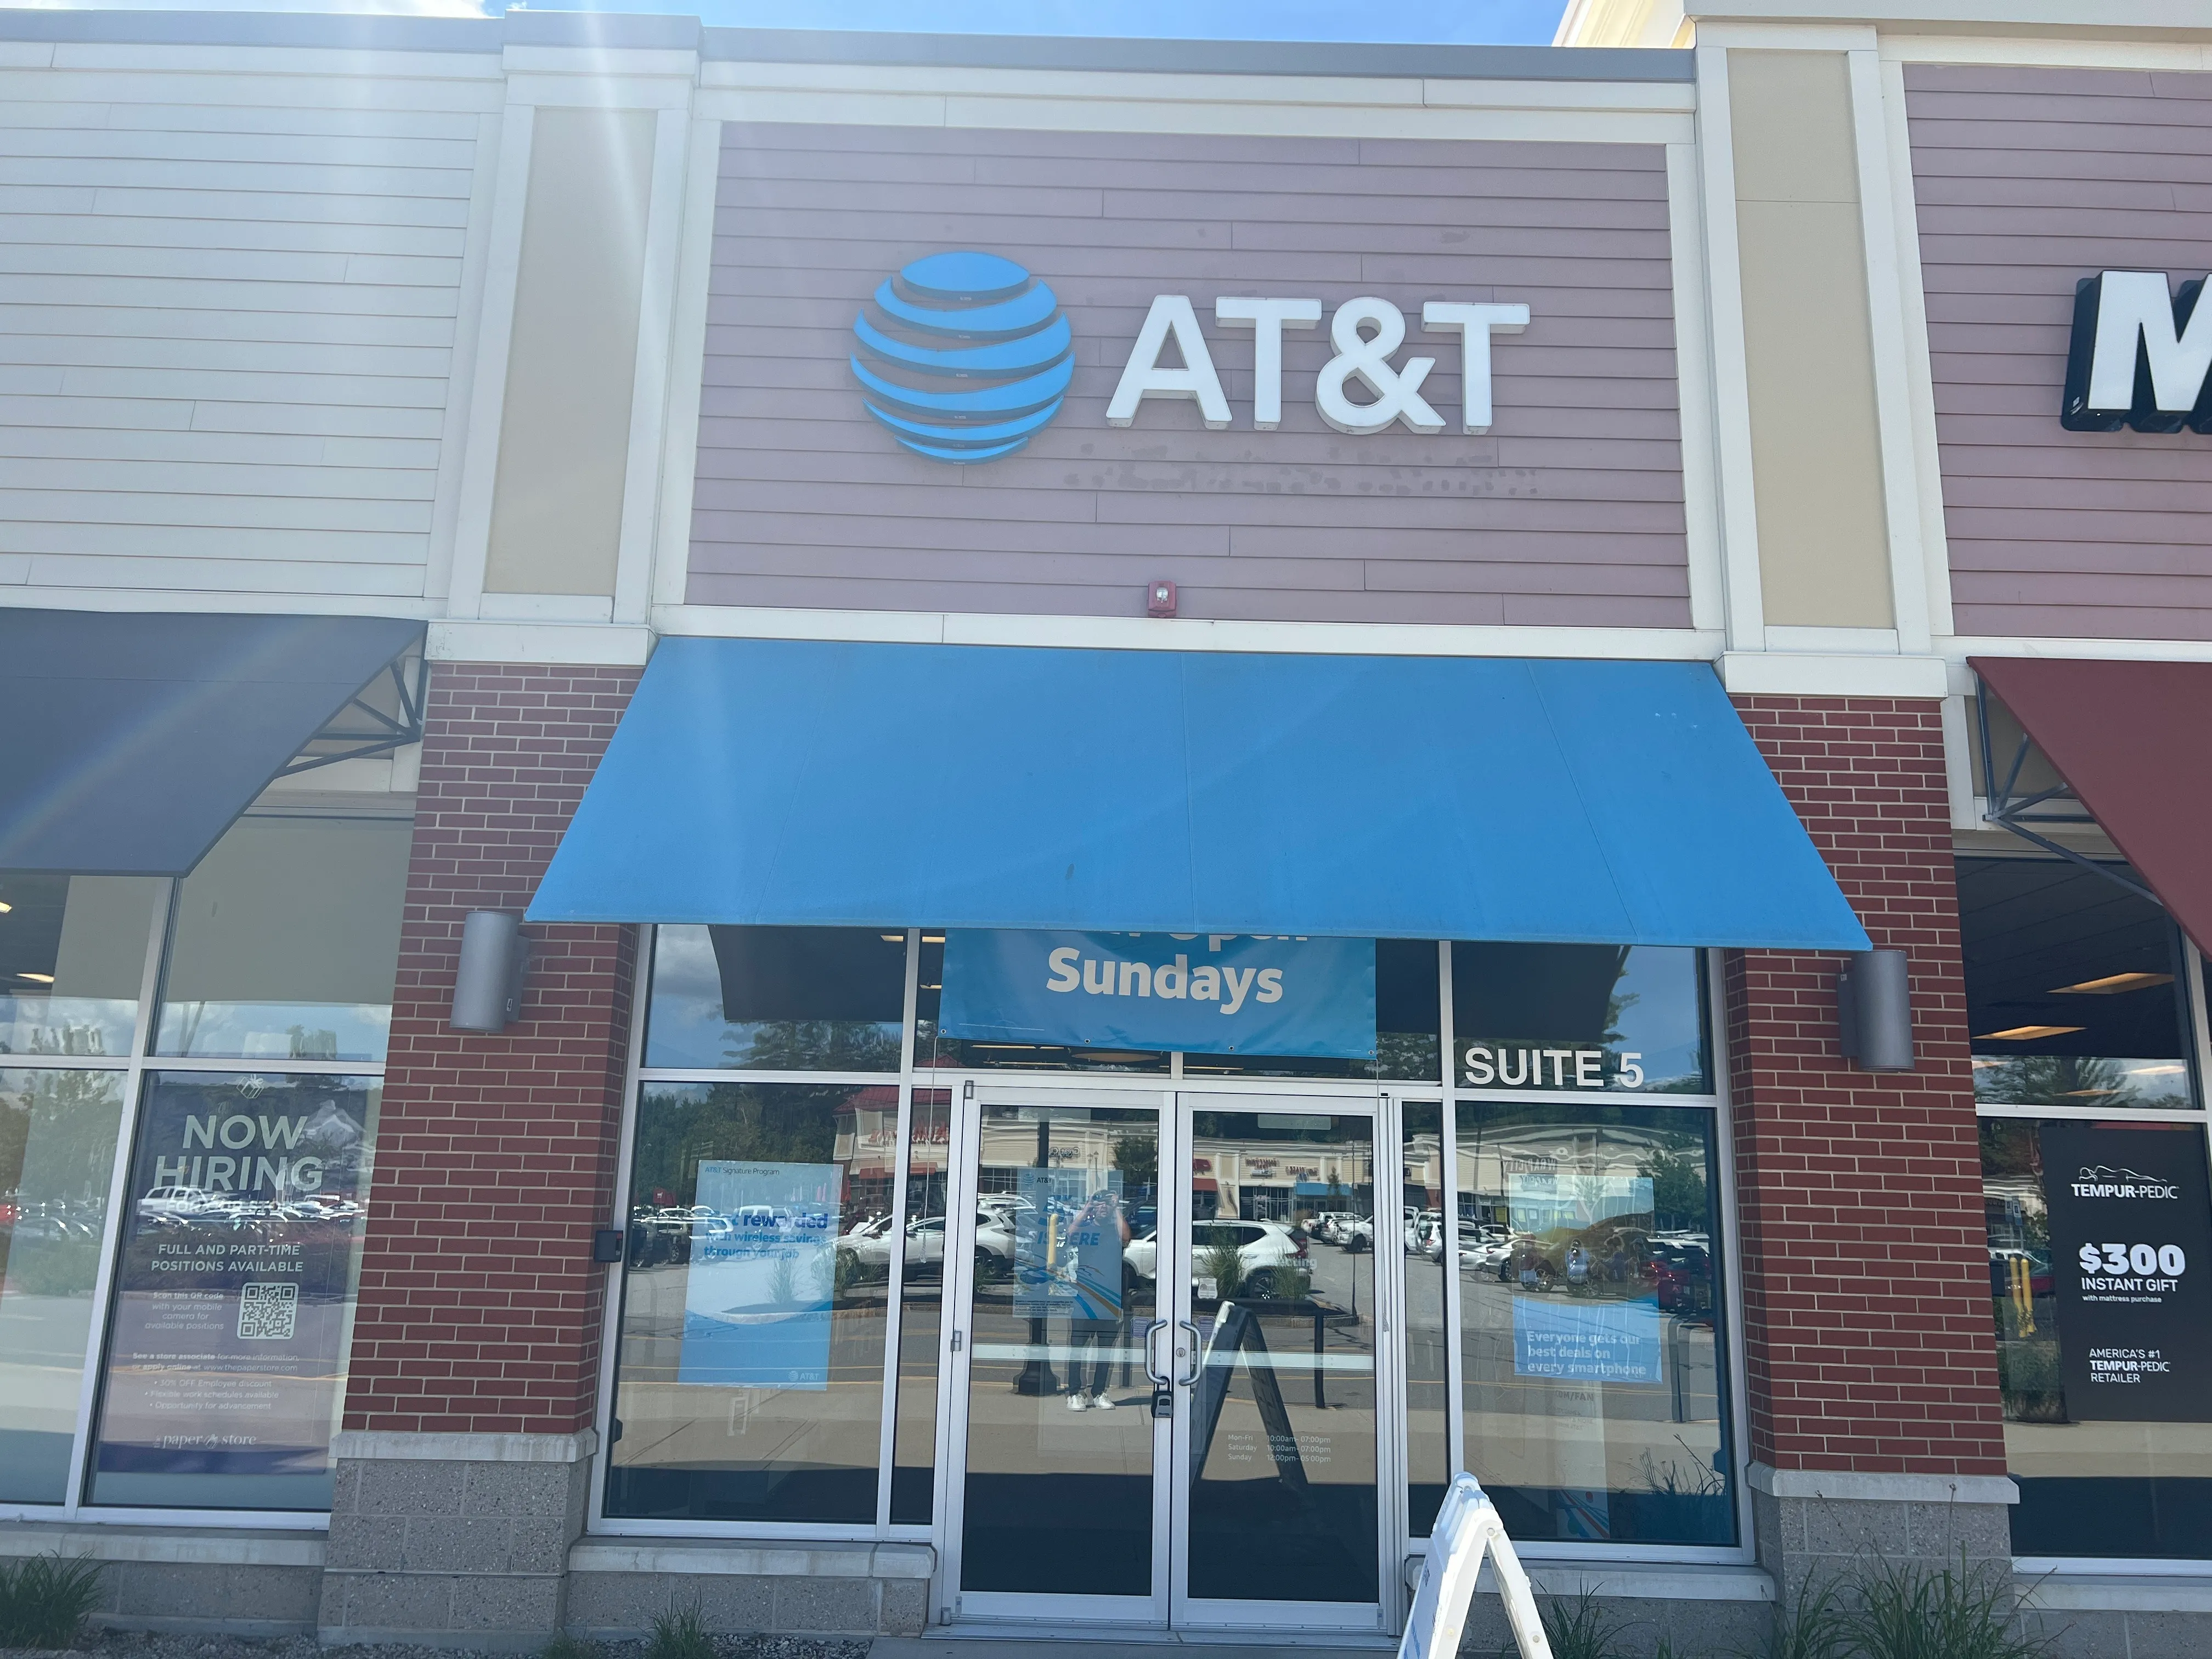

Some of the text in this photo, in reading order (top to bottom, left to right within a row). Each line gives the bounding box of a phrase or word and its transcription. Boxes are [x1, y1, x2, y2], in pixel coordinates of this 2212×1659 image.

[1105, 294, 1530, 436] AT&T
[1046, 946, 1284, 1015] Sundays
[1464, 1048, 1644, 1088] SUITE 5
[183, 1114, 308, 1150] NOW
[153, 1155, 323, 1192] HIRING
[723, 1166, 752, 1175] Signature
[753, 1167, 780, 1176] Program
[735, 1231, 781, 1243] wireless
[158, 1244, 301, 1256] FULL AND PART-TIME
[151, 1260, 303, 1272] POSITIONS AVAILABLE
[2079, 1243, 2186, 1277] $300
[2081, 1277, 2178, 1292] INSTANT GIFT
[153, 1291, 172, 1300] Scan
[174, 1291, 188, 1300] this
[151, 1302, 170, 1311] with
[197, 1312, 210, 1321] for
[144, 1322, 224, 1330] available positions
[1527, 1331, 1641, 1346] Everyone gets our
[1527, 1345, 1611, 1359] best deals on
[2089, 1348, 2160, 1359] AMERICA'S #1
[1527, 1362, 1647, 1376] every smartphone
[198, 1380, 237, 1388] Employee
[2090, 1373, 2141, 1384] RETAILER
[204, 1390, 242, 1398] schedules
[155, 1401, 204, 1410] Opportunity
[163, 1434, 203, 1449] paper
[221, 1433, 257, 1446] store
[1301, 1436, 1331, 1444] 07:00pm
[1228, 1443, 1257, 1453] Saturday
[1228, 1453, 1252, 1462] Sunday
[1301, 1454, 1331, 1463] 05:00pm
